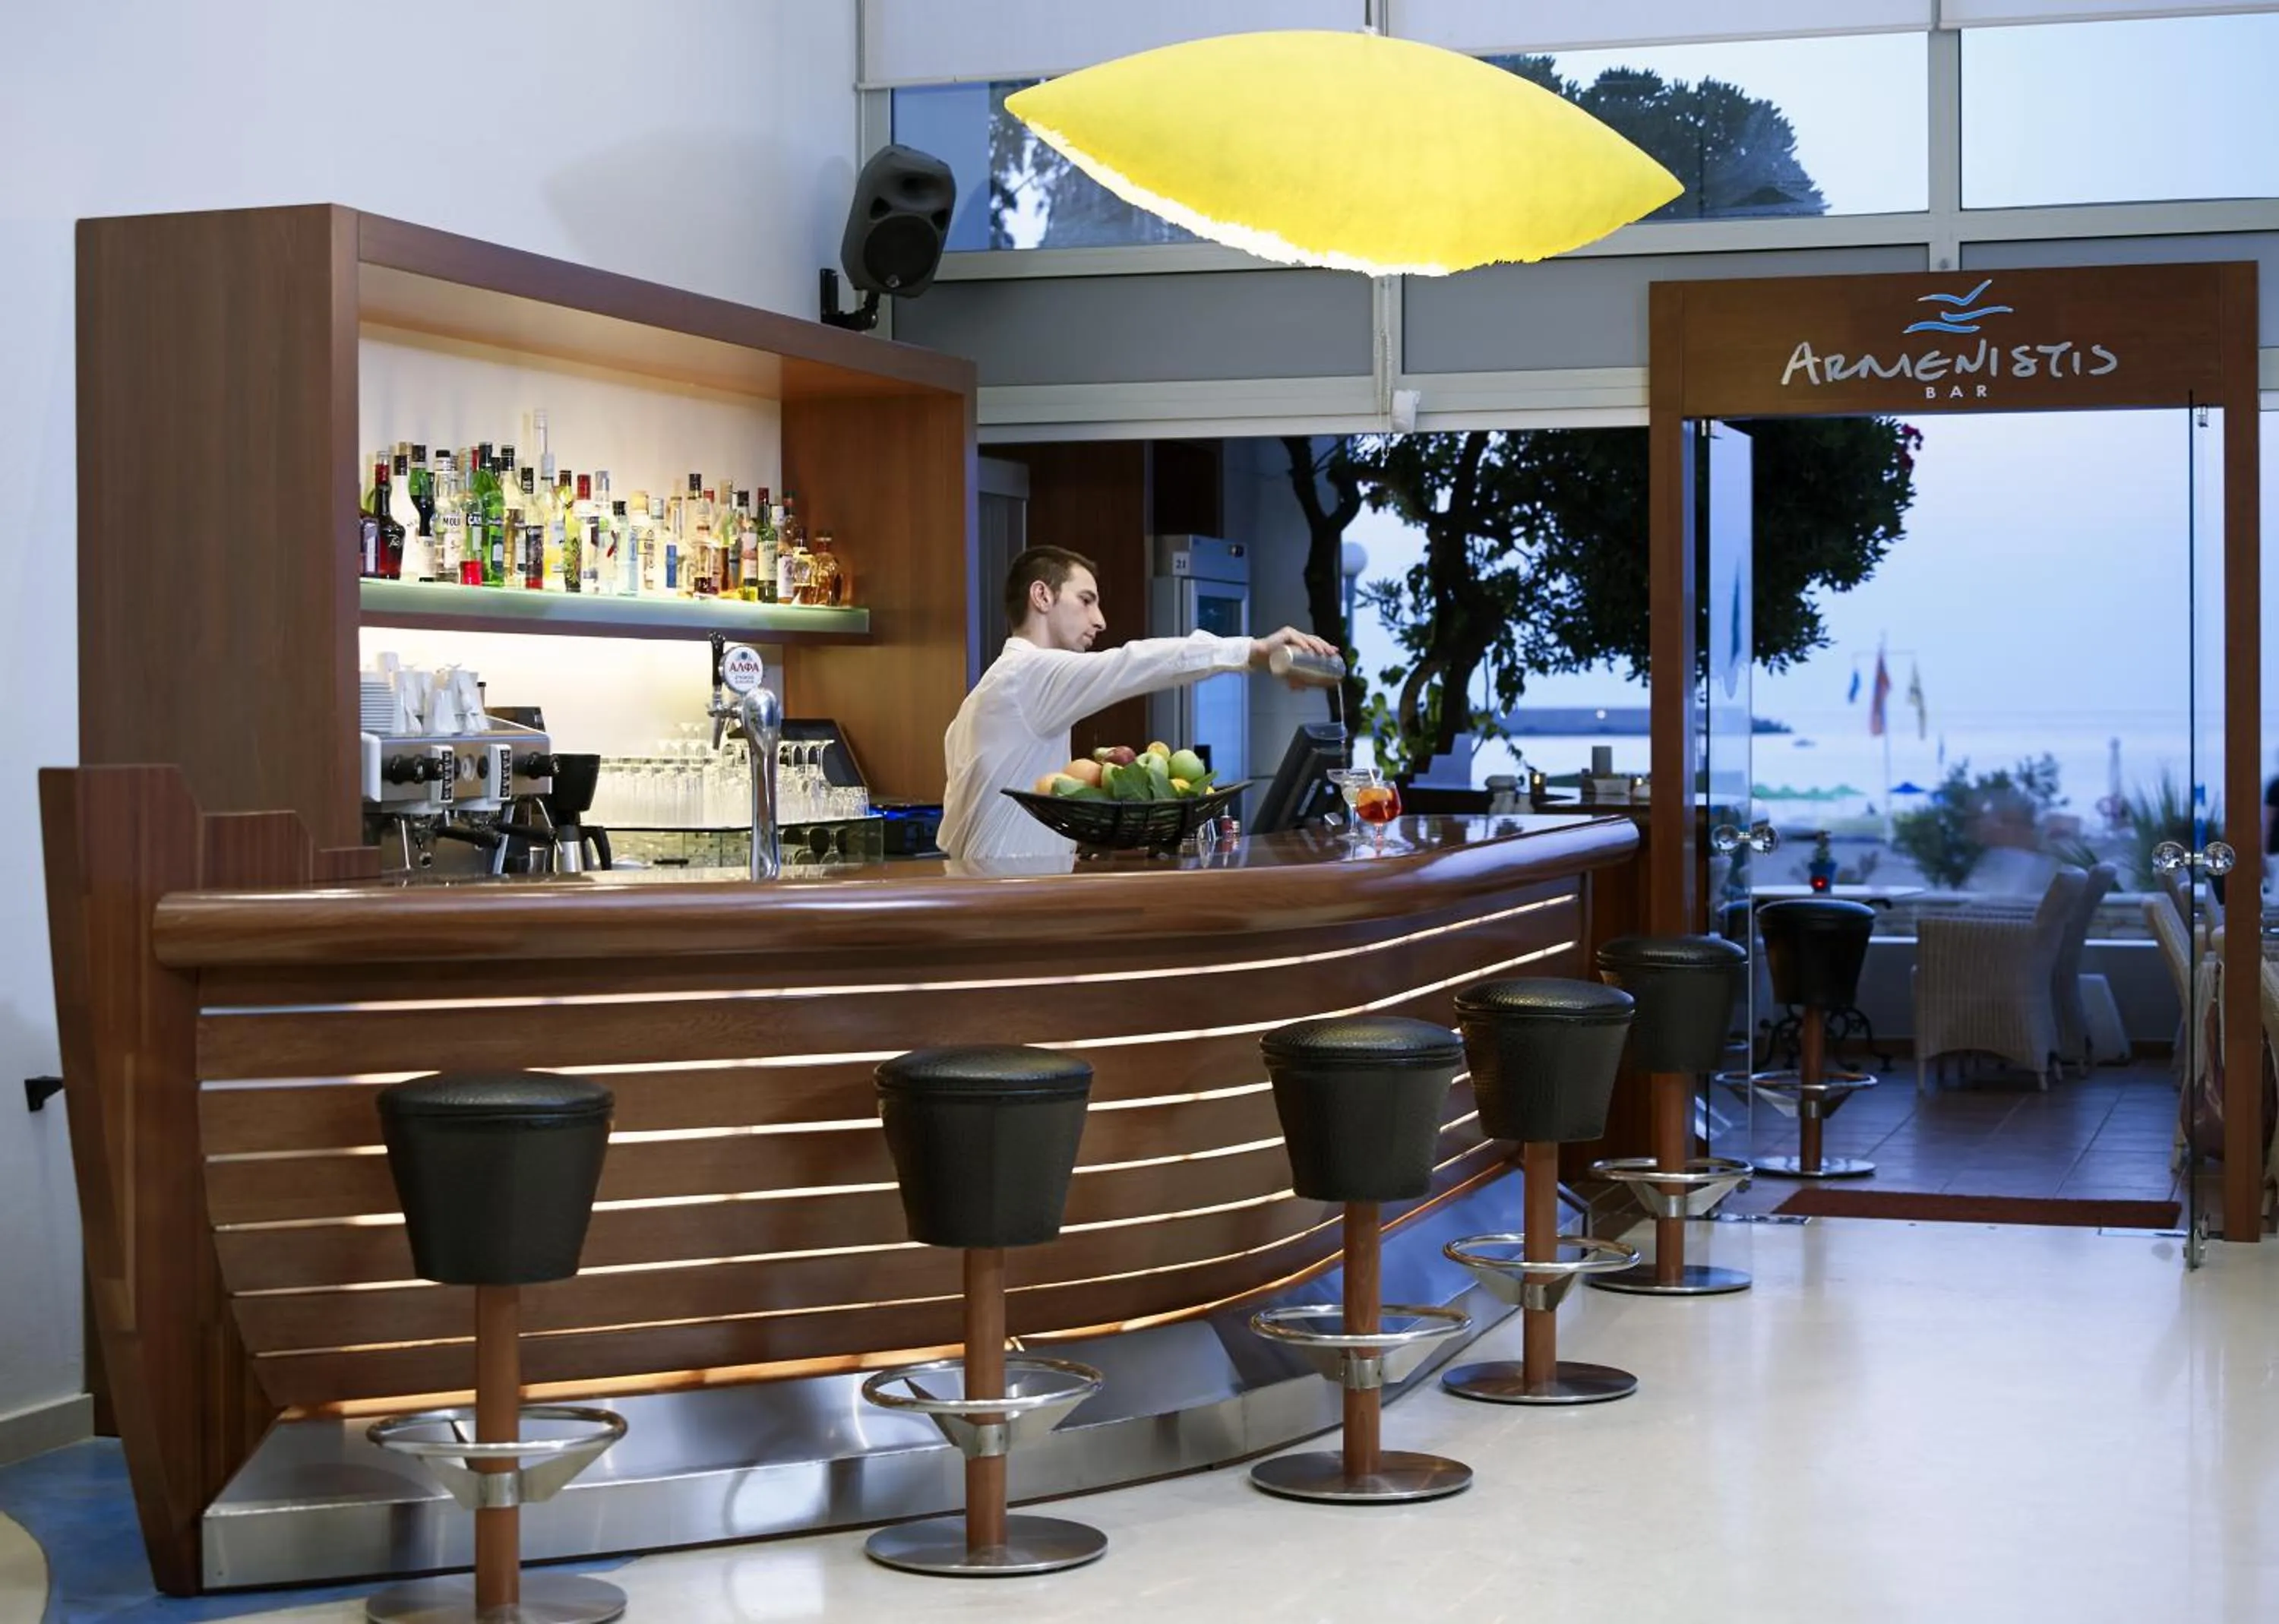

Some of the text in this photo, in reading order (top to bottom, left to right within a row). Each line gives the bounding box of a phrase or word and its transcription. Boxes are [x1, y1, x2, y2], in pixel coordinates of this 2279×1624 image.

[1781, 339, 2118, 385] ARMENISTIS
[1925, 385, 1988, 399] BAR
[1175, 559, 1187, 569] 21
